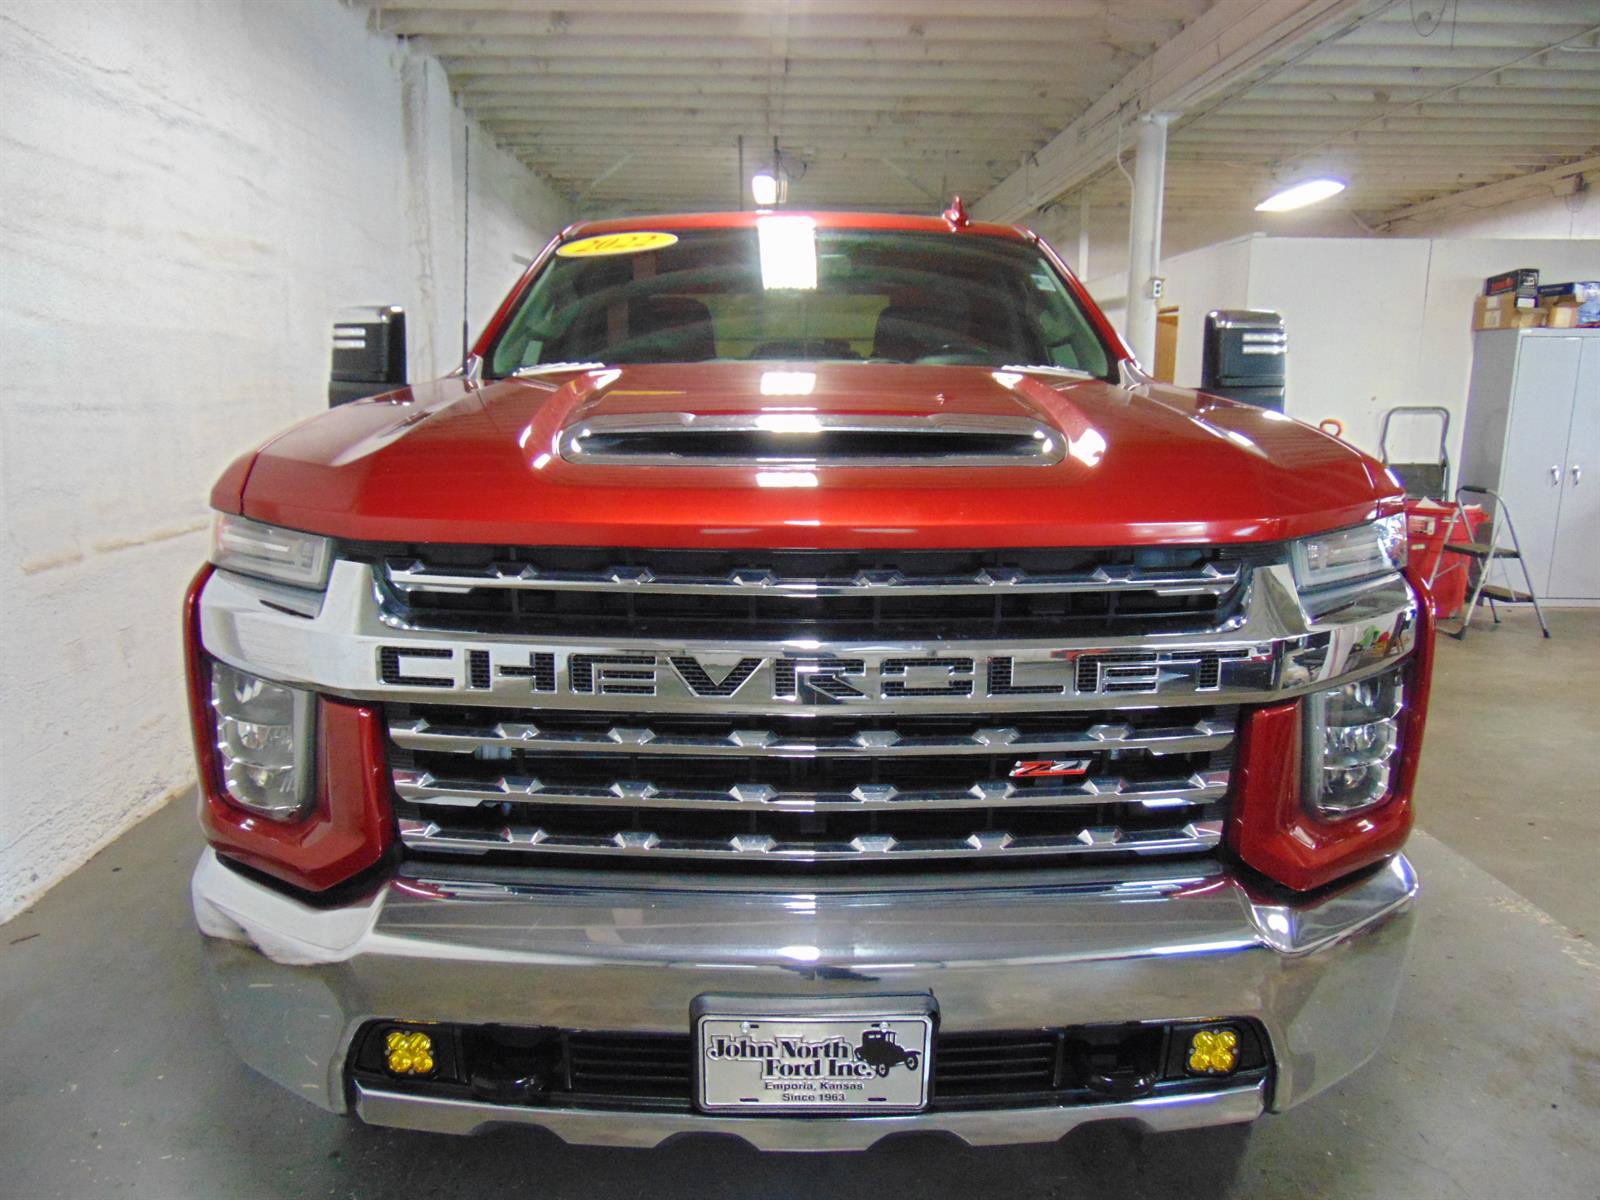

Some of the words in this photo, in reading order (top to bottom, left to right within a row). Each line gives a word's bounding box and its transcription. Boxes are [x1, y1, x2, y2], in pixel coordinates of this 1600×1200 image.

[376, 644, 1252, 702] CHEVROLET
[1008, 759, 1092, 777] Z71
[708, 1037, 775, 1059] John
[779, 1038, 850, 1059] North
[764, 1058, 822, 1078] Ford
[827, 1058, 873, 1078] Inc.
[764, 1081, 817, 1092] Emporia,
[819, 1081, 864, 1091] Kansas
[781, 1093, 816, 1102] Since
[818, 1093, 846, 1102] 1963
